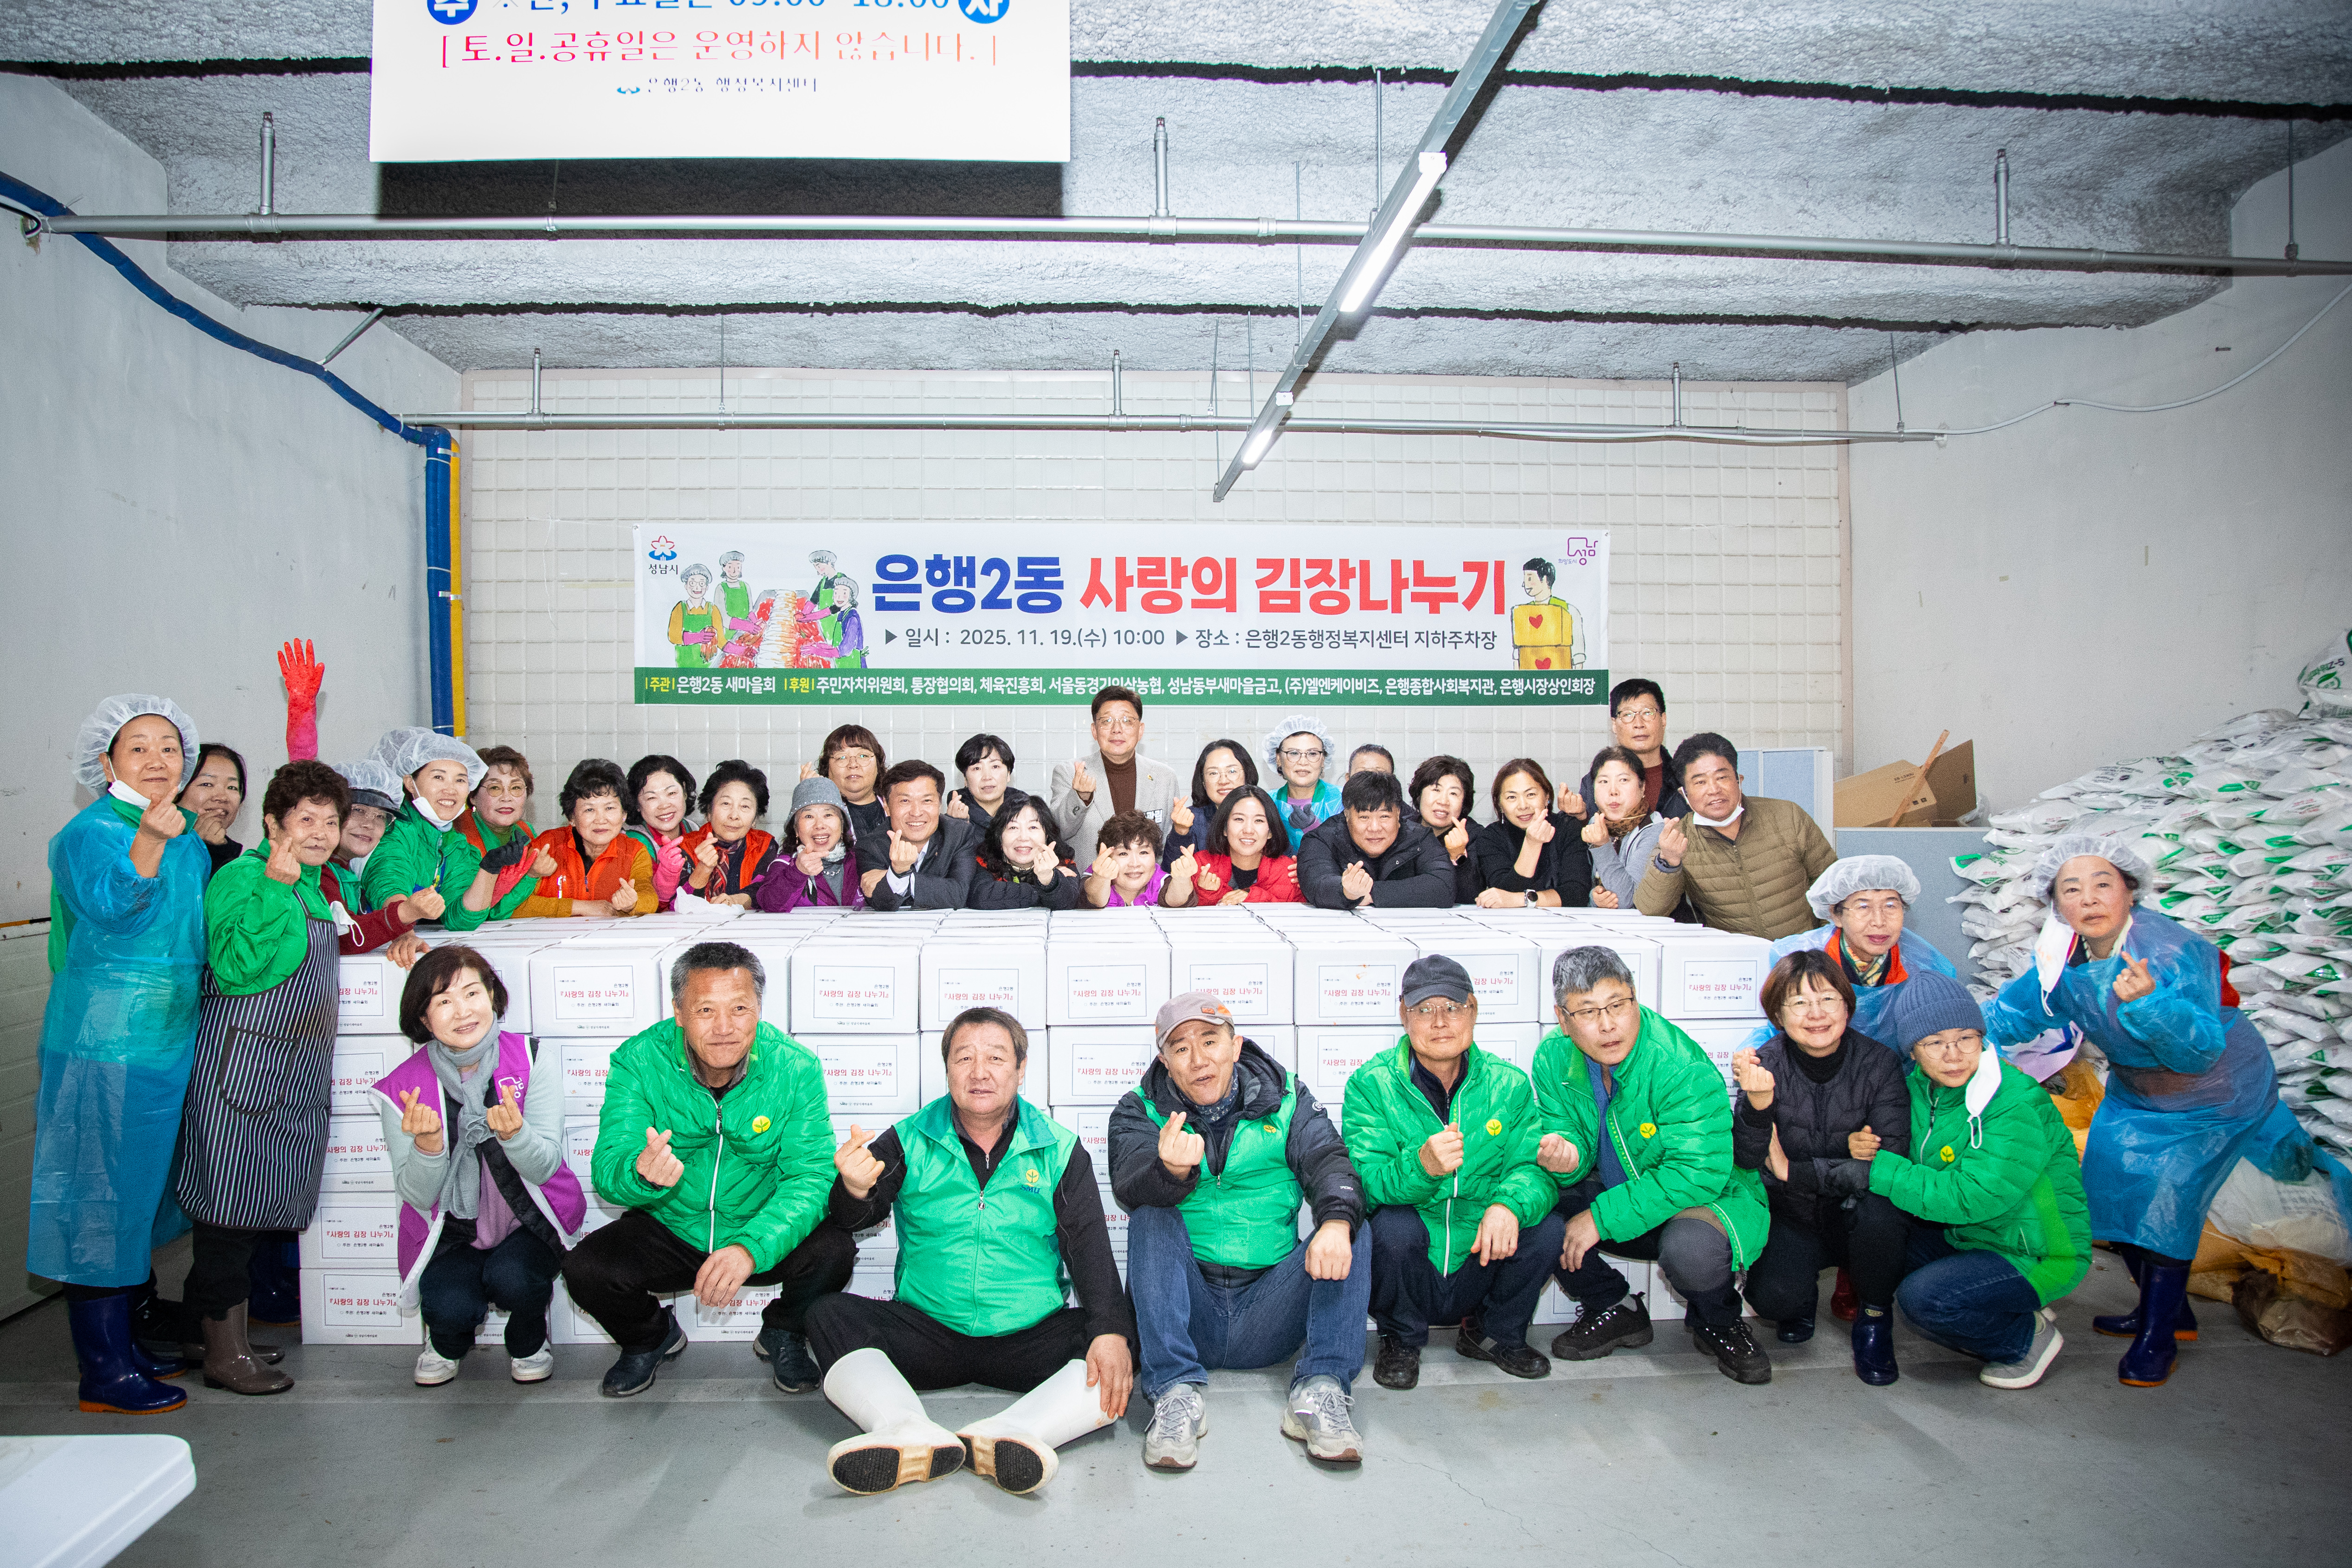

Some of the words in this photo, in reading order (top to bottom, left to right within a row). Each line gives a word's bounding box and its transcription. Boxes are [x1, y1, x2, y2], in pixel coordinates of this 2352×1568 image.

[693, 30, 820, 61] 운영하지
[649, 564, 678, 575] 성남시
[872, 554, 1064, 614] 은행2동
[1080, 556, 1237, 614] 사랑의
[1255, 558, 1506, 616] 김장나누기
[961, 629, 1011, 645] 2025.
[1018, 630, 1044, 645] 11.
[1114, 630, 1165, 645] 10:00
[1246, 629, 1409, 650] 은행2동행정복지센터
[1415, 631, 1498, 651] 지하주차장
[677, 677, 723, 694] 은행2동
[726, 677, 775, 694] 새마을회
[817, 677, 908, 695] 주민자치위원회,
[911, 677, 977, 695] 통장협의회,
[980, 677, 1047, 695] 체육진흥회,
[1168, 677, 1283, 696] 성남동부새마을금고,
[1385, 678, 1498, 696] 은행종합사회복지관,
[1500, 678, 1599, 696] 은행시장상인회장
